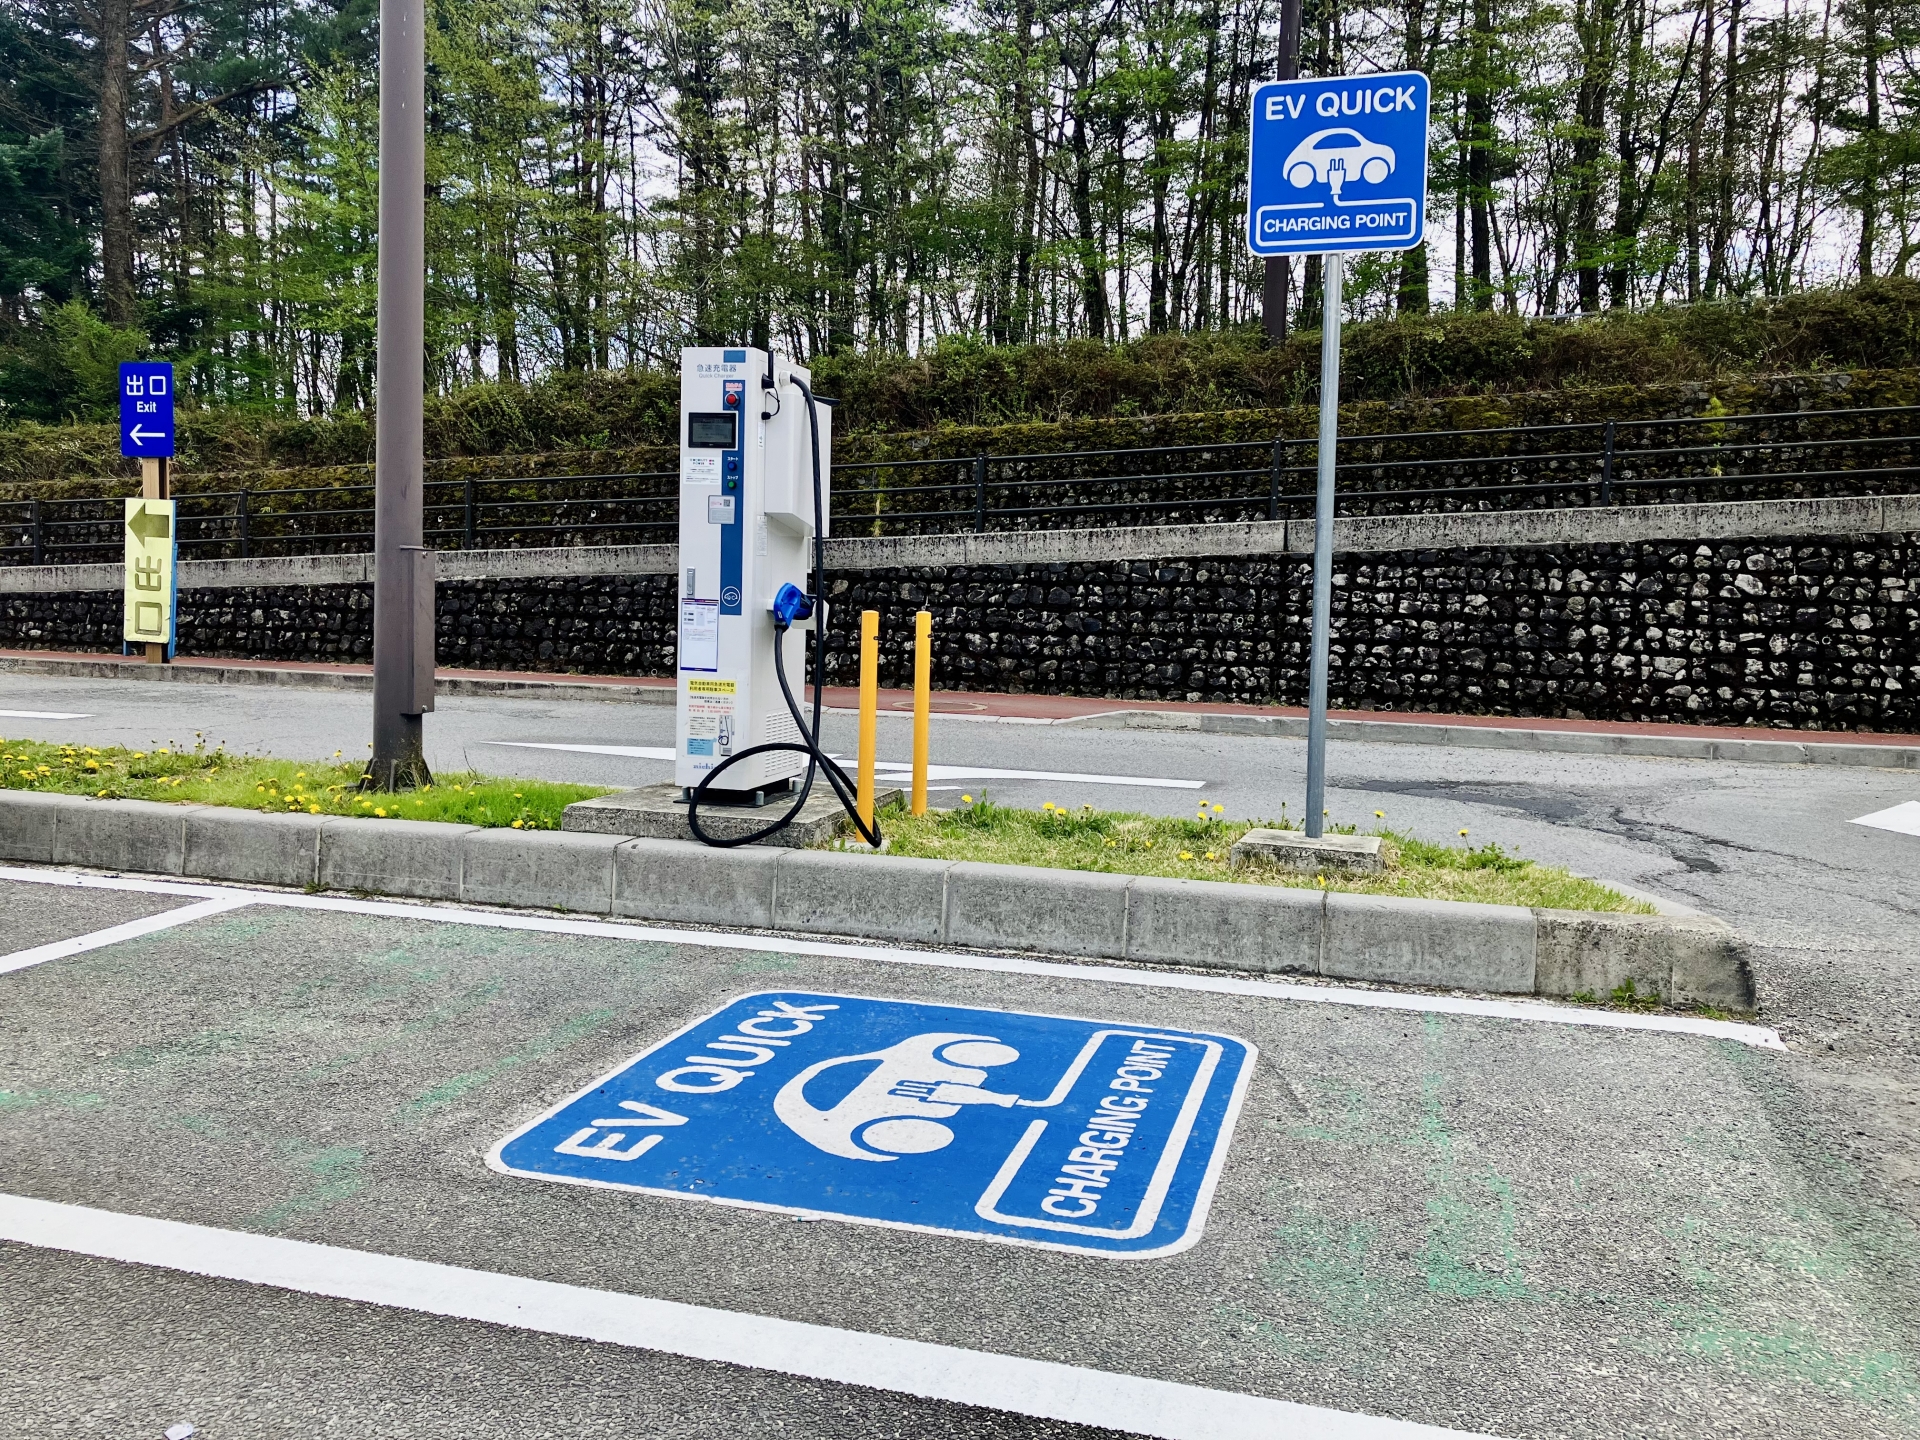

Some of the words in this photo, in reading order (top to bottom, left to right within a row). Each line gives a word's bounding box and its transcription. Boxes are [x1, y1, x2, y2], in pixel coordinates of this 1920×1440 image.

[1266, 94, 1306, 120] EV
[1316, 86, 1416, 117] QUICK
[1264, 216, 1350, 233] CHARGING
[1355, 212, 1408, 229] POINT
[696, 363, 737, 373] 急速充電器
[126, 374, 167, 396] 出口
[136, 401, 157, 413] Exit
[134, 555, 162, 636] 出口
[553, 1101, 690, 1161] EV
[655, 1001, 841, 1094] QUICK
[1041, 1096, 1149, 1217] CHARGING
[1109, 1040, 1176, 1093] POINT
